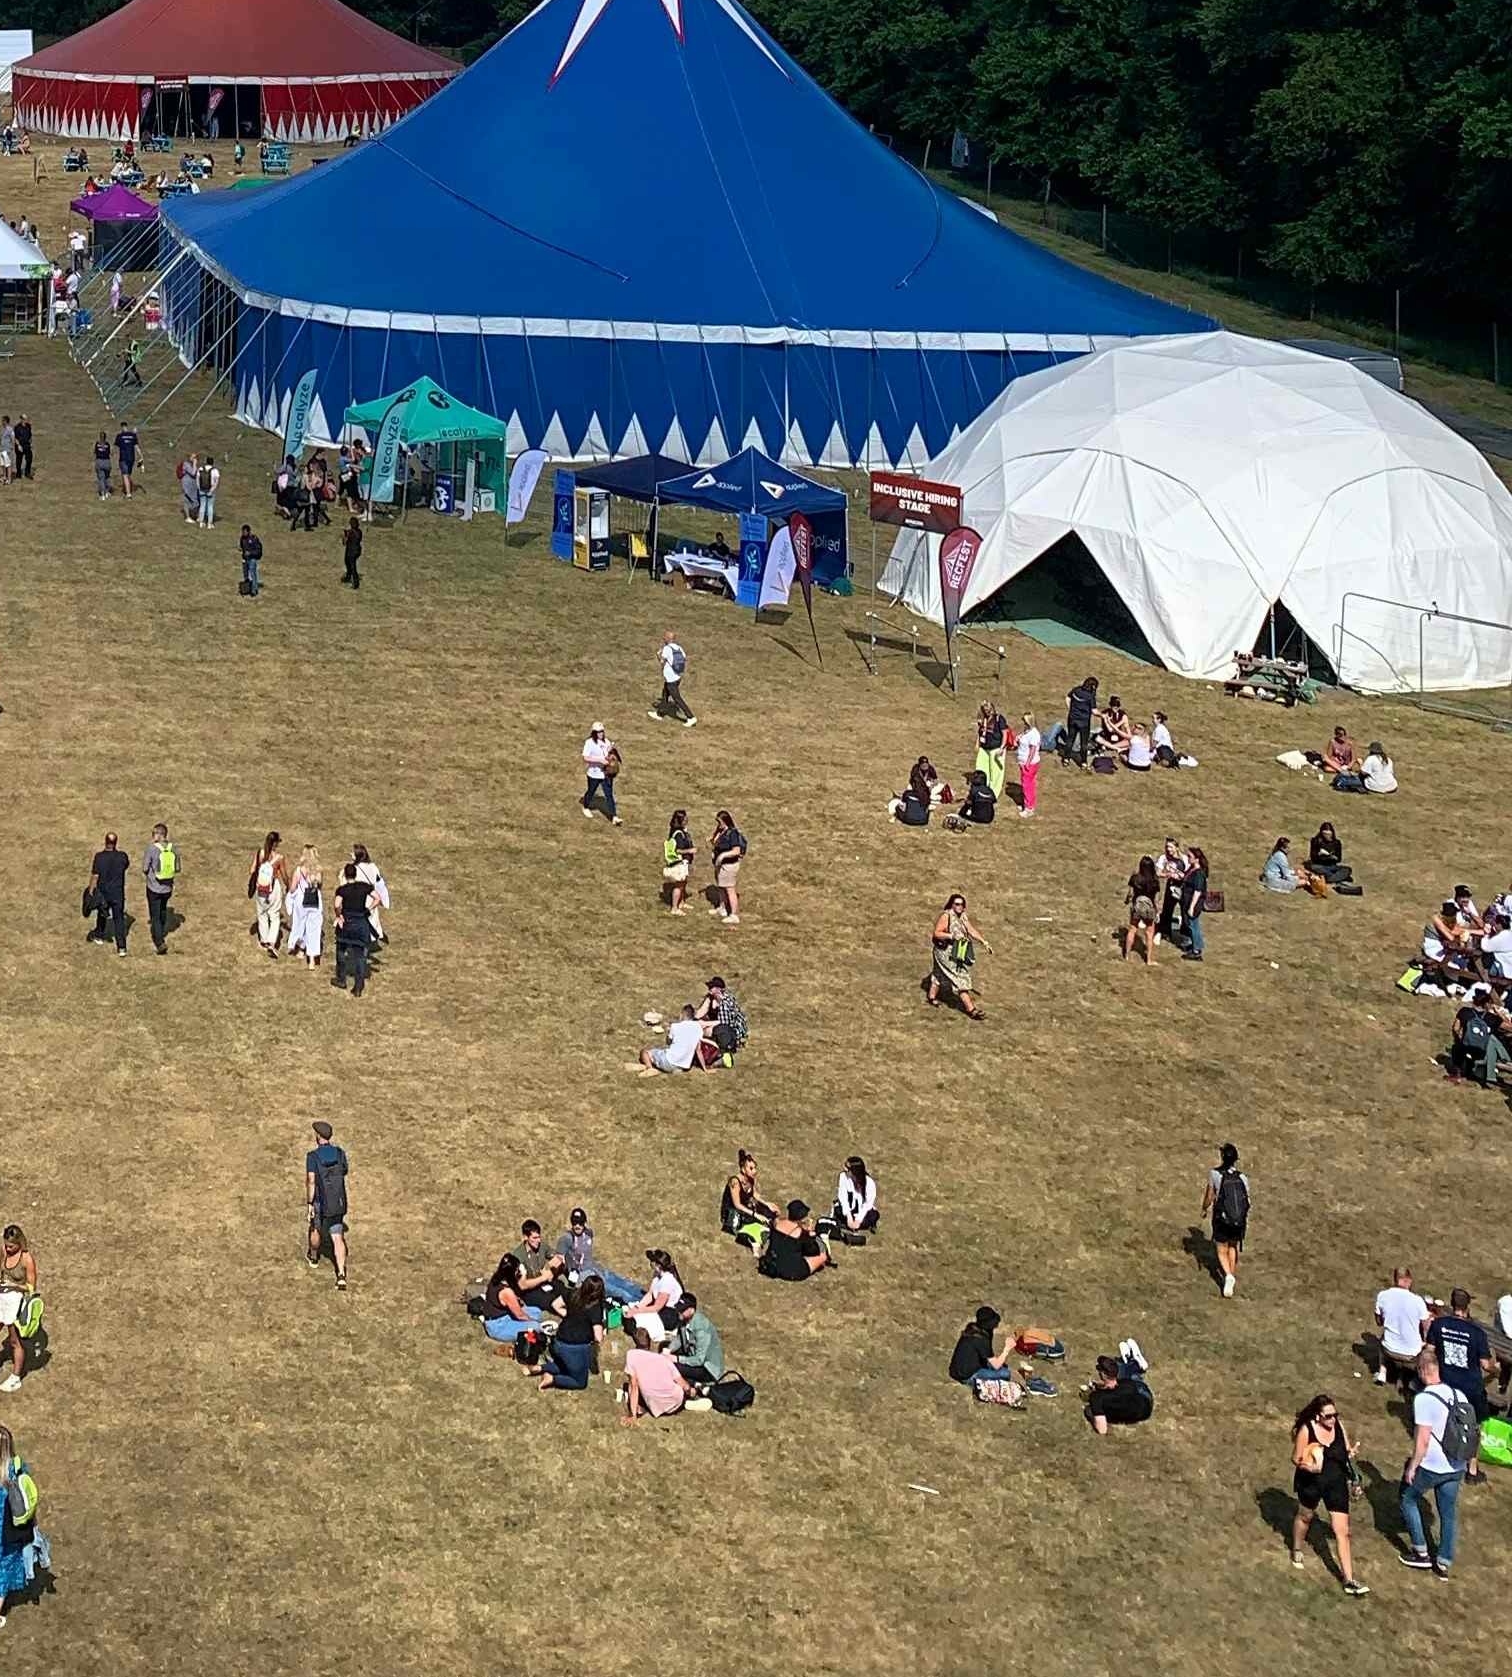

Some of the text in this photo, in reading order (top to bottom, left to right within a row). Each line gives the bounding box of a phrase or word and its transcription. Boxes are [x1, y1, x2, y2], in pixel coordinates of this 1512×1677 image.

[378, 415, 401, 479] localyze
[873, 482, 958, 507] INCLUSIVE HIRING
[898, 499, 931, 514] STAGE
[949, 539, 974, 590] RECFEST
